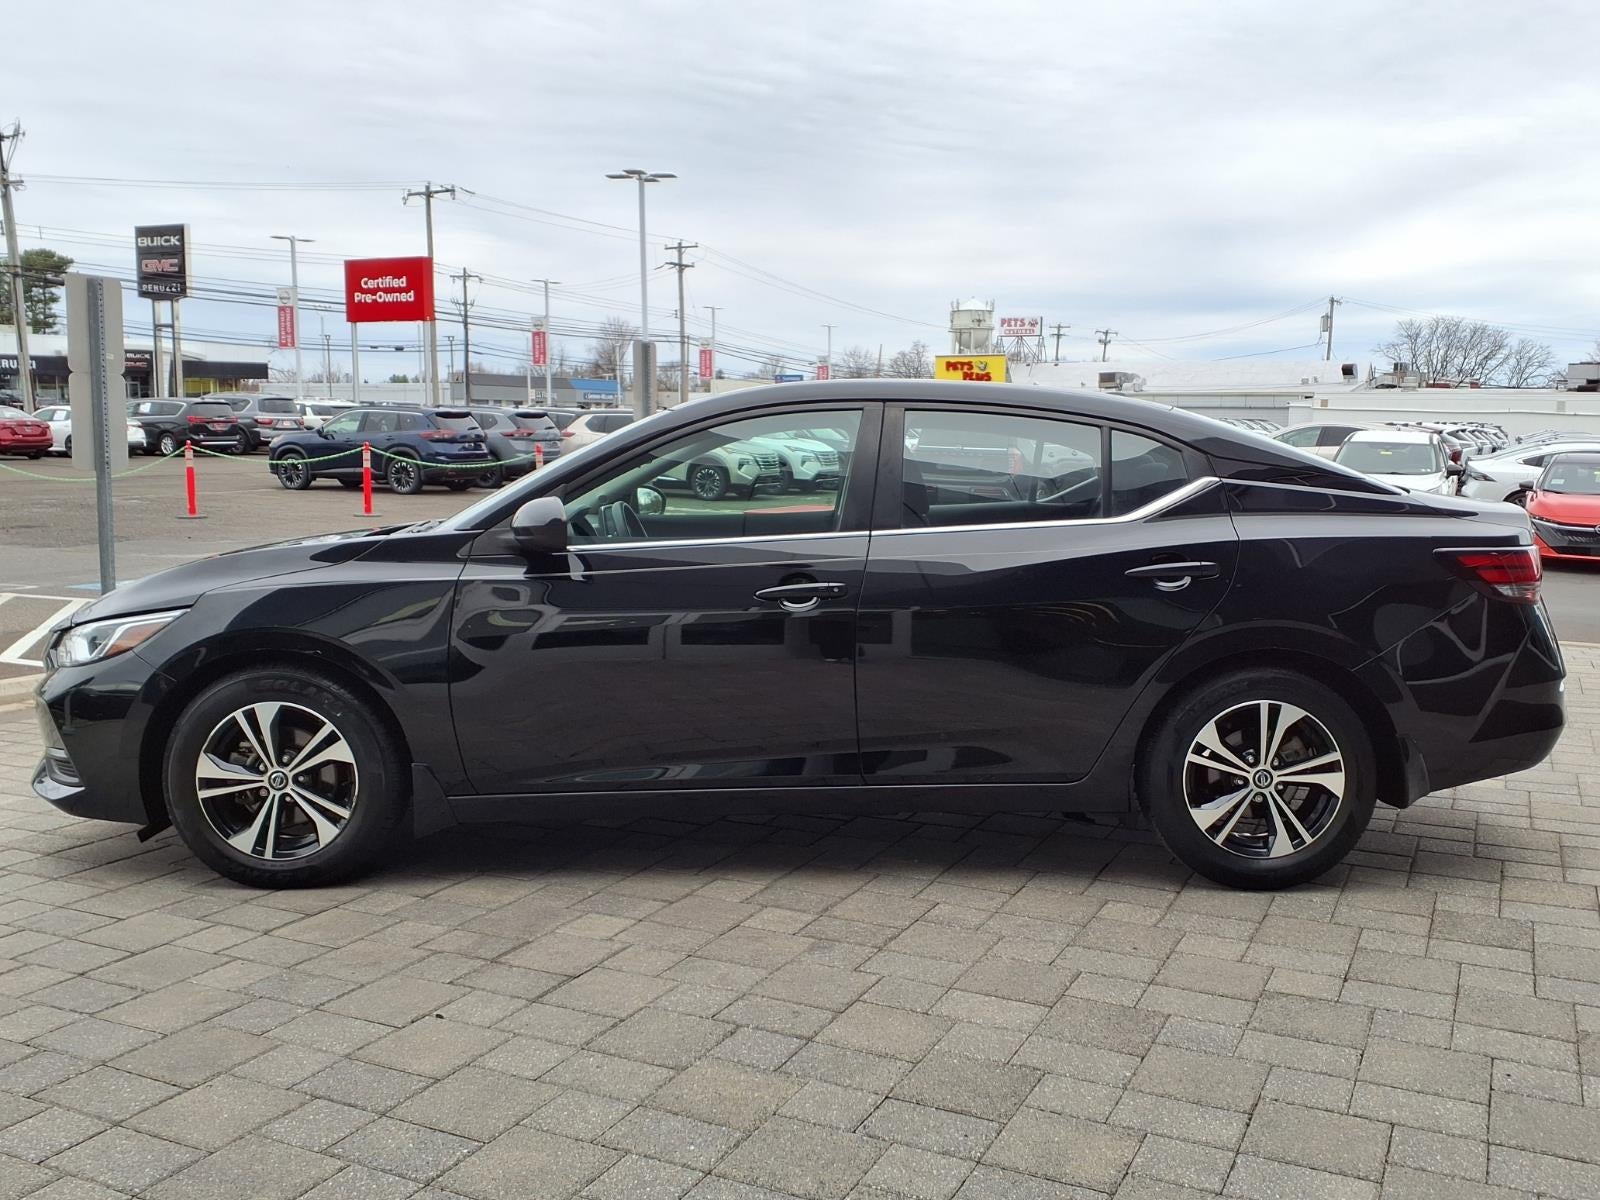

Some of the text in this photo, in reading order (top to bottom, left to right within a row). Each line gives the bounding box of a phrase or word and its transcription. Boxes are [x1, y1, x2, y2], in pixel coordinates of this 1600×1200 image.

[138, 236, 180, 247] BUICK
[142, 259, 178, 271] GMC
[361, 276, 406, 288] Certified
[354, 290, 415, 303] Pre-Owned
[1001, 318, 1025, 327] PETS
[945, 361, 974, 371] PETS
